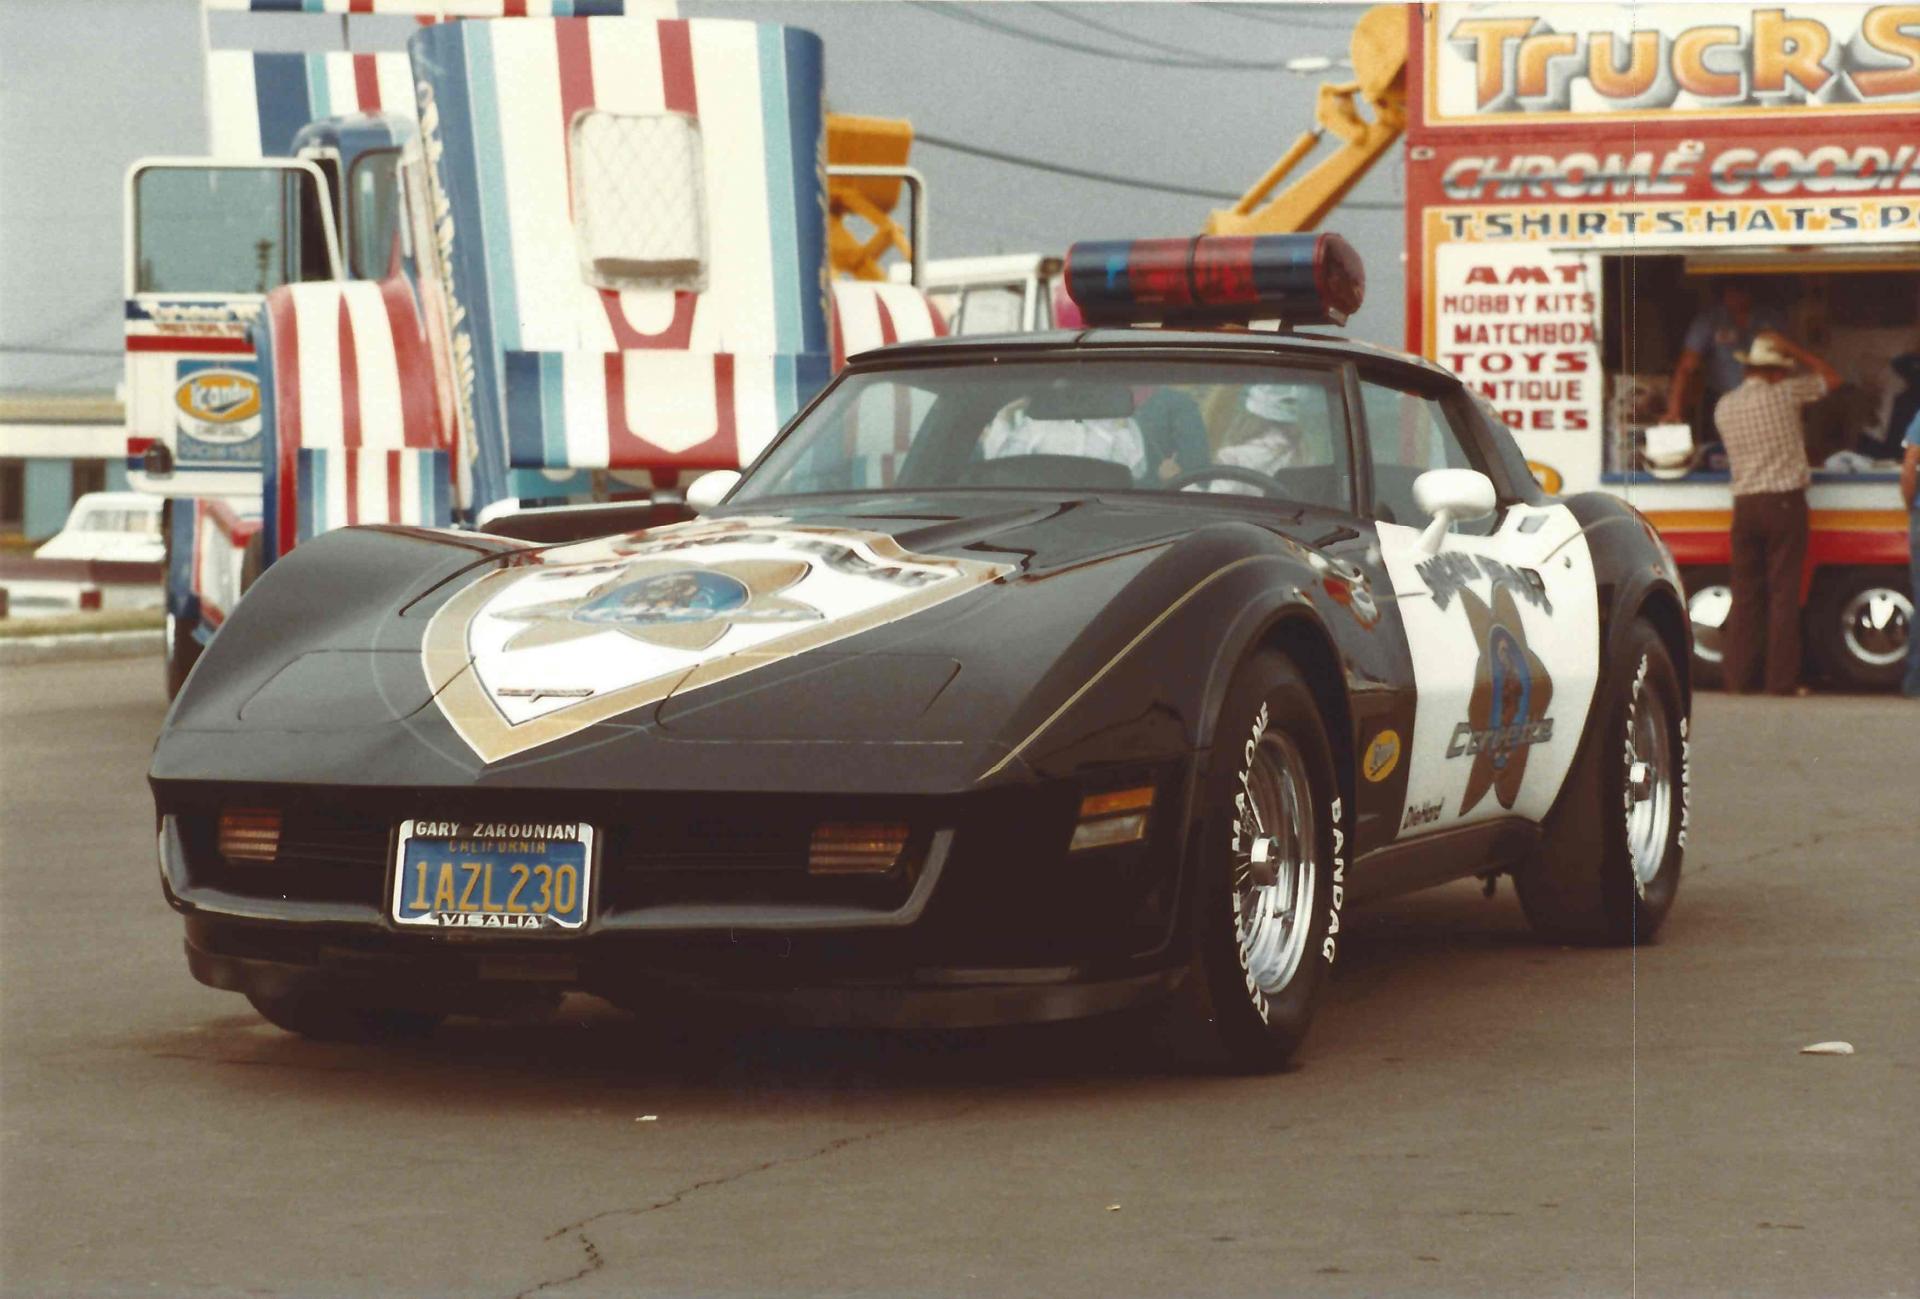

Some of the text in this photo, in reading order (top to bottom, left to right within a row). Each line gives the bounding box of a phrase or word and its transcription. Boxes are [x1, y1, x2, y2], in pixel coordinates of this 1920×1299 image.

[1442, 150, 1693, 199] CHROME
[1707, 207, 1858, 232] HATS
[1881, 205, 1919, 228] P
[1465, 264, 1588, 285] AMT
[1444, 291, 1595, 315] HOBBY KITS
[1454, 322, 1594, 345] MATCHBOX
[1442, 352, 1588, 374] TOYS
[1467, 380, 1582, 401] NTIQUE
[1499, 409, 1590, 431] RES
[415, 821, 577, 839] GARY ZAROUNIAN
[449, 840, 547, 854] CALIFORNIA
[408, 861, 578, 914] 1AZL230
[1323, 796, 1345, 964] BANDAG
[440, 913, 542, 928] VISALIA
